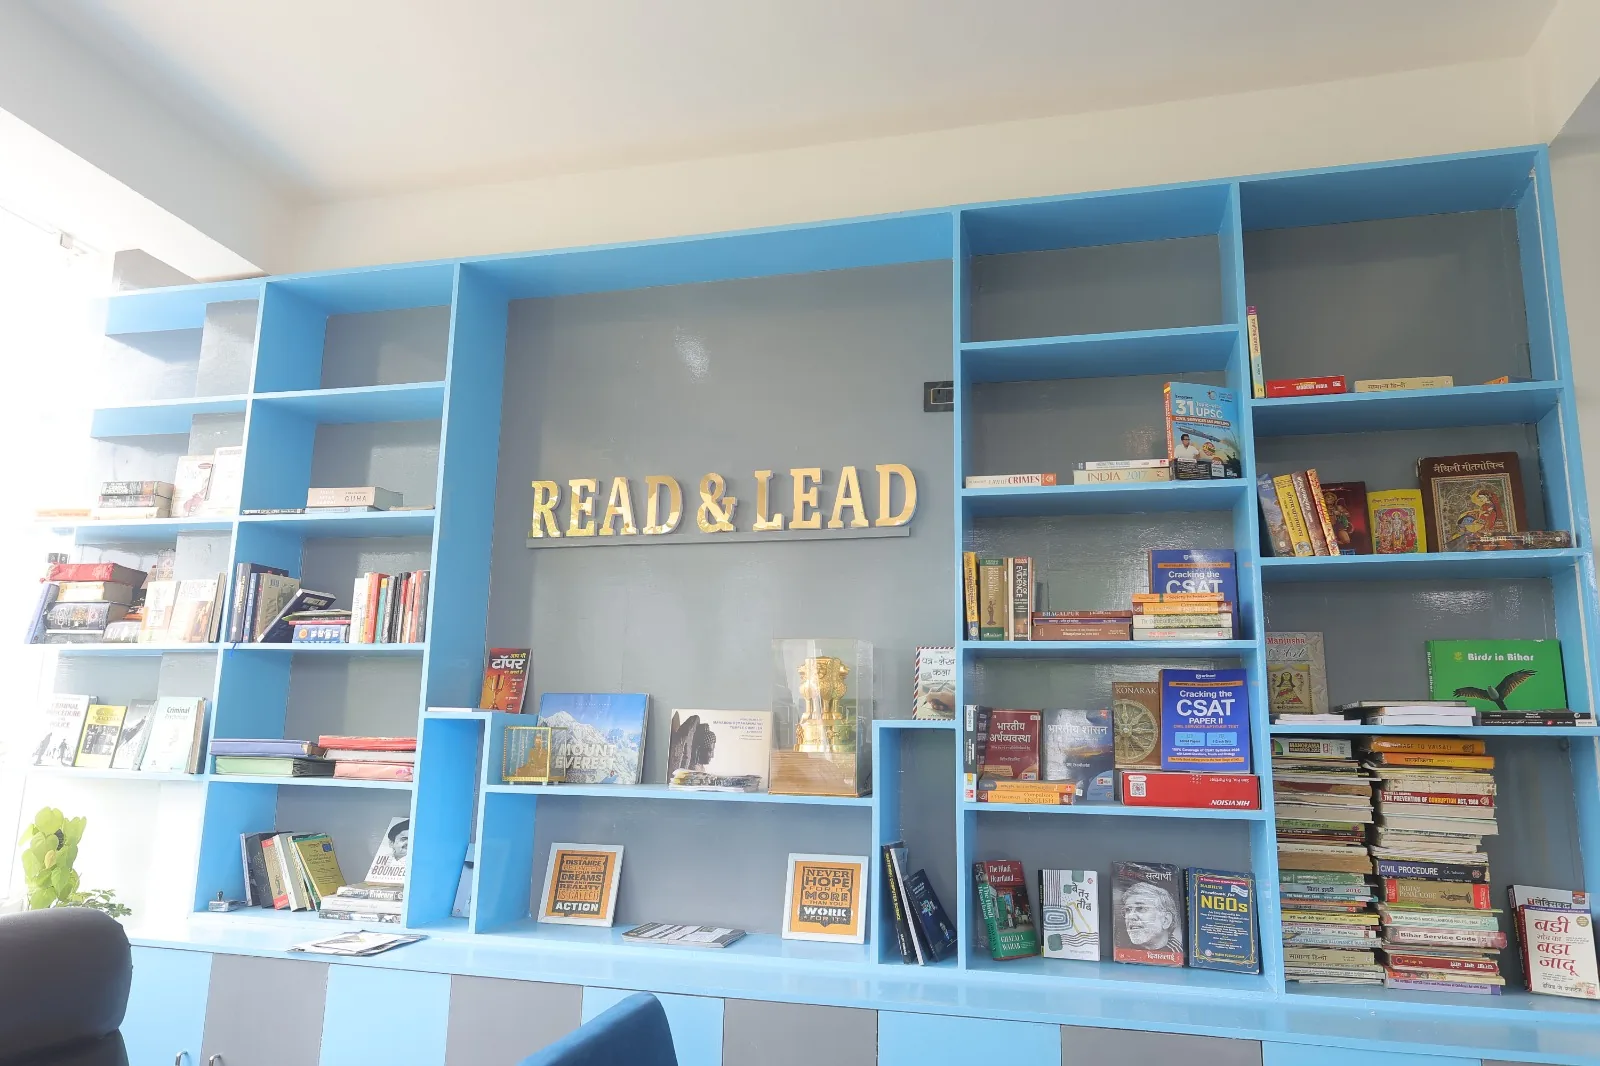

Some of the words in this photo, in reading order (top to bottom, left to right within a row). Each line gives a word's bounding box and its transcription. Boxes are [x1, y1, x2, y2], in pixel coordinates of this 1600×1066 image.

[1175, 400, 1194, 416] 31
[1196, 408, 1223, 419] UPSC
[1433, 463, 1460, 474] मैथिली
[1008, 475, 1040, 484] CRIMES
[1088, 472, 1120, 482] INDIA
[1124, 470, 1148, 481] 2017
[528, 475, 684, 538] READ
[697, 472, 738, 533] &
[753, 464, 918, 531] LEAD
[1168, 570, 1200, 581] Cracking
[1165, 580, 1223, 594] CSAT
[1267, 636, 1306, 645] Manjusha
[492, 655, 526, 670] टॉपर
[1468, 652, 1492, 662] Birds
[1495, 652, 1504, 662] in
[1508, 652, 1534, 662] Bihar
[932, 668, 951, 677] कला
[1116, 686, 1158, 694] KONARAK
[1180, 690, 1217, 699] Cracking
[166, 706, 191, 714] Criminal
[1176, 698, 1236, 716] CSAT
[997, 720, 1025, 731] भारतीय
[1048, 724, 1080, 734] भारतीय
[1082, 725, 1108, 735] शासन
[990, 731, 1031, 744] अर्थव्यवस्था
[558, 743, 617, 757] MOUNT
[555, 756, 616, 770] EVEREST
[376, 856, 390, 866] UN
[566, 859, 602, 867] DISTANCE
[806, 868, 850, 878] NEVER
[998, 865, 1012, 873] Hindi
[1380, 865, 1398, 873] CIVIL
[1398, 866, 1438, 876] PROCEDURE
[561, 873, 602, 882] DREAMS
[805, 876, 850, 888] HOPE
[1145, 872, 1172, 881] सत्यार्थी
[558, 890, 566, 900] IS
[568, 890, 599, 901] CALLED
[804, 891, 848, 902] MORE
[555, 902, 599, 912] ACTION
[1201, 895, 1248, 912] NGOs
[804, 906, 847, 917] WORK
[1534, 916, 1571, 934] बड़ी
[1537, 942, 1572, 956] बड़ा
[1540, 956, 1580, 976] जादू
